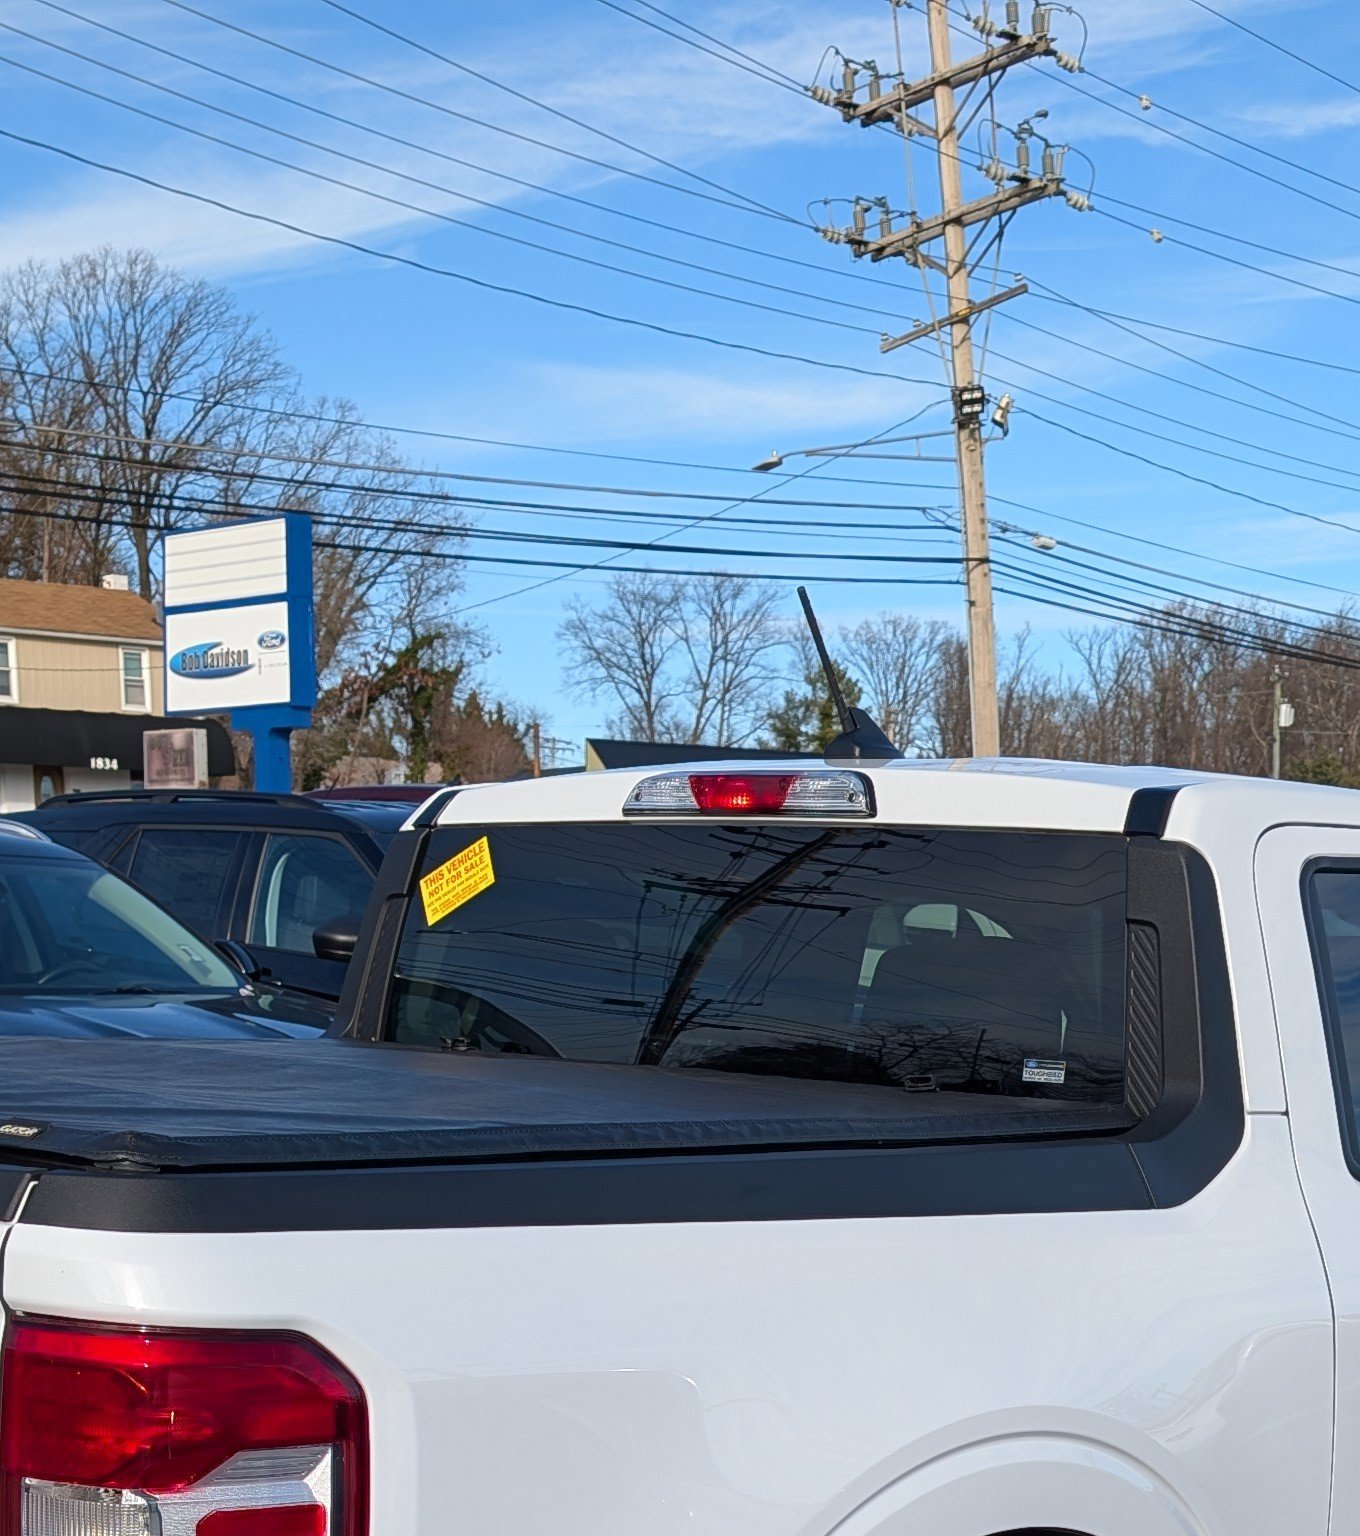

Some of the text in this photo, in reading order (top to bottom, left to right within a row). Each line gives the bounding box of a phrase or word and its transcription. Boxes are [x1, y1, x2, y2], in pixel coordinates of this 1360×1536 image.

[181, 651, 200, 671] Bob
[202, 647, 249, 669] Davidson
[90, 757, 118, 770] 1834
[423, 841, 486, 890] THIS VEHICLE
[428, 855, 485, 899] NOT FOR SALE
